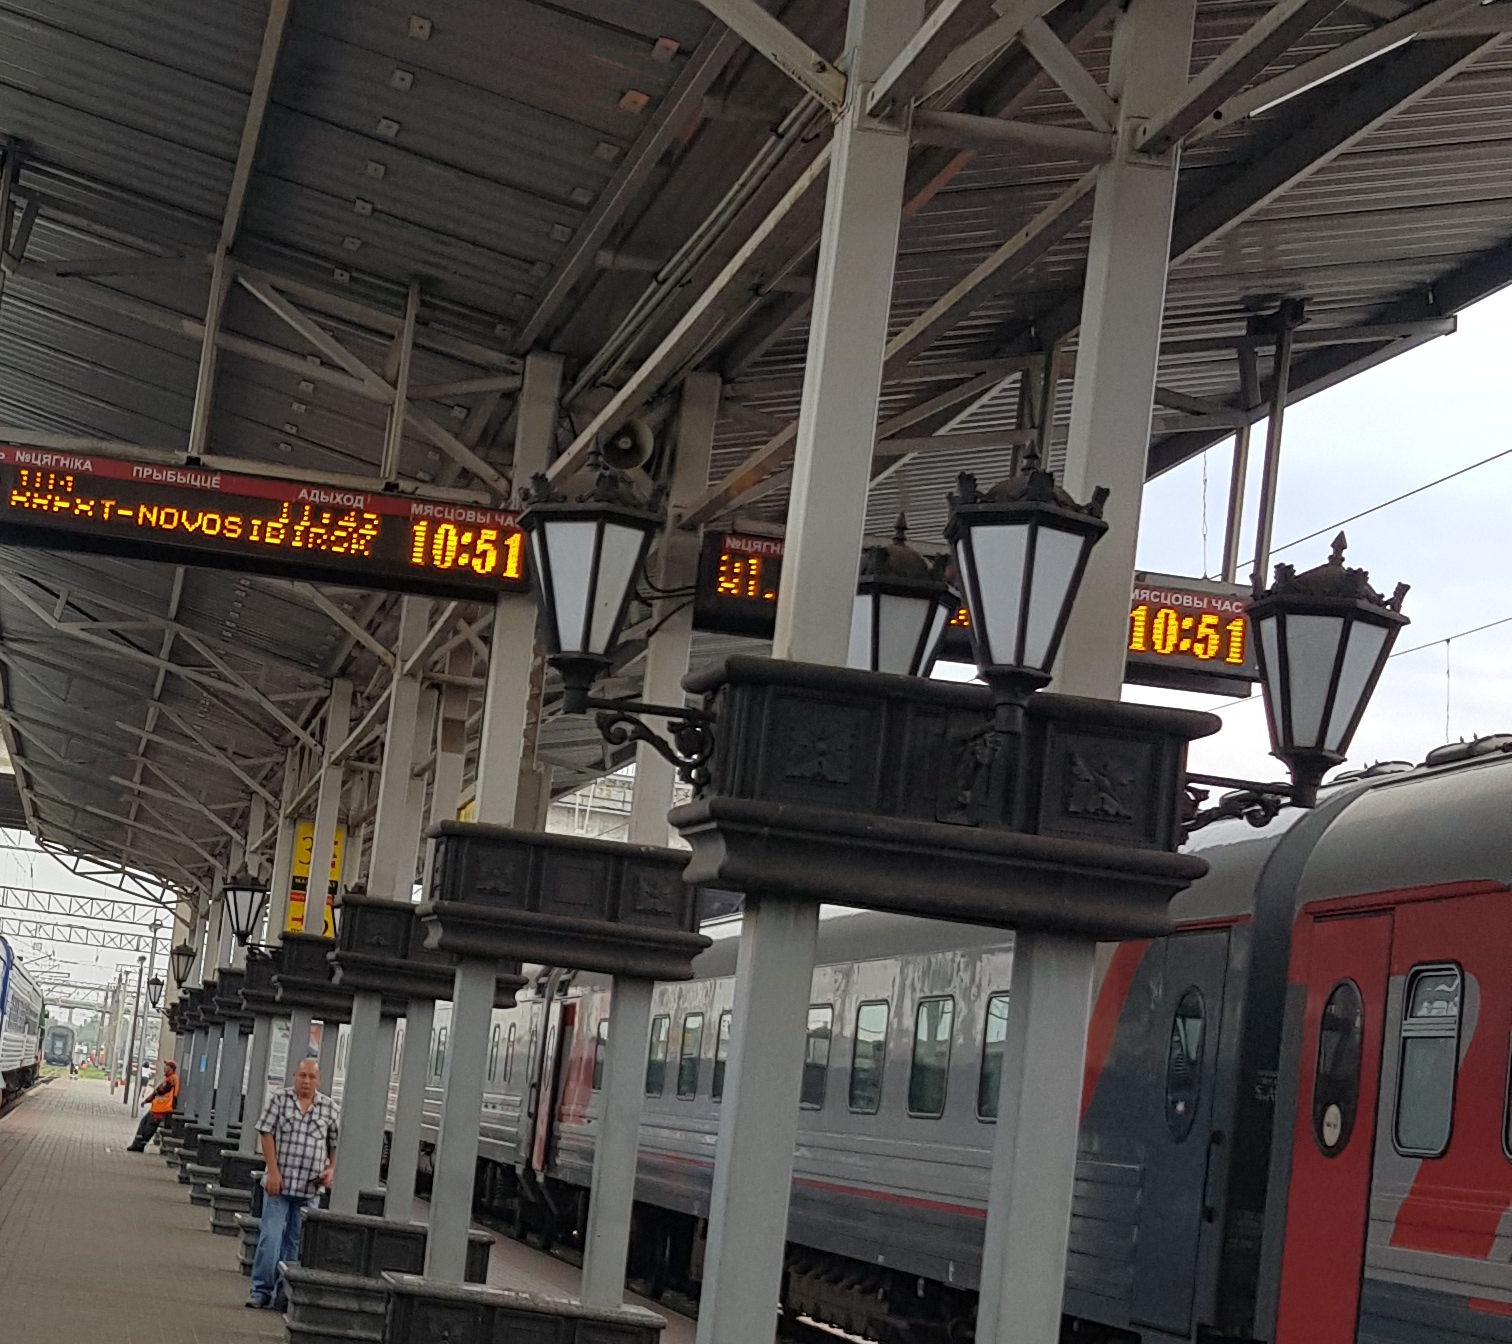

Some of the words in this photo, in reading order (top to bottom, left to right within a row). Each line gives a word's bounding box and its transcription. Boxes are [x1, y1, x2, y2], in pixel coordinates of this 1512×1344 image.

[15, 450, 93, 472] №ЦЯГНІКА
[298, 488, 365, 510] АДЫХОД
[410, 502, 489, 524] МЯСЦОВЫ
[411, 520, 522, 578] 10:51
[1129, 605, 1244, 665] 10:51
[1211, 598, 1243, 613] ЧАС
